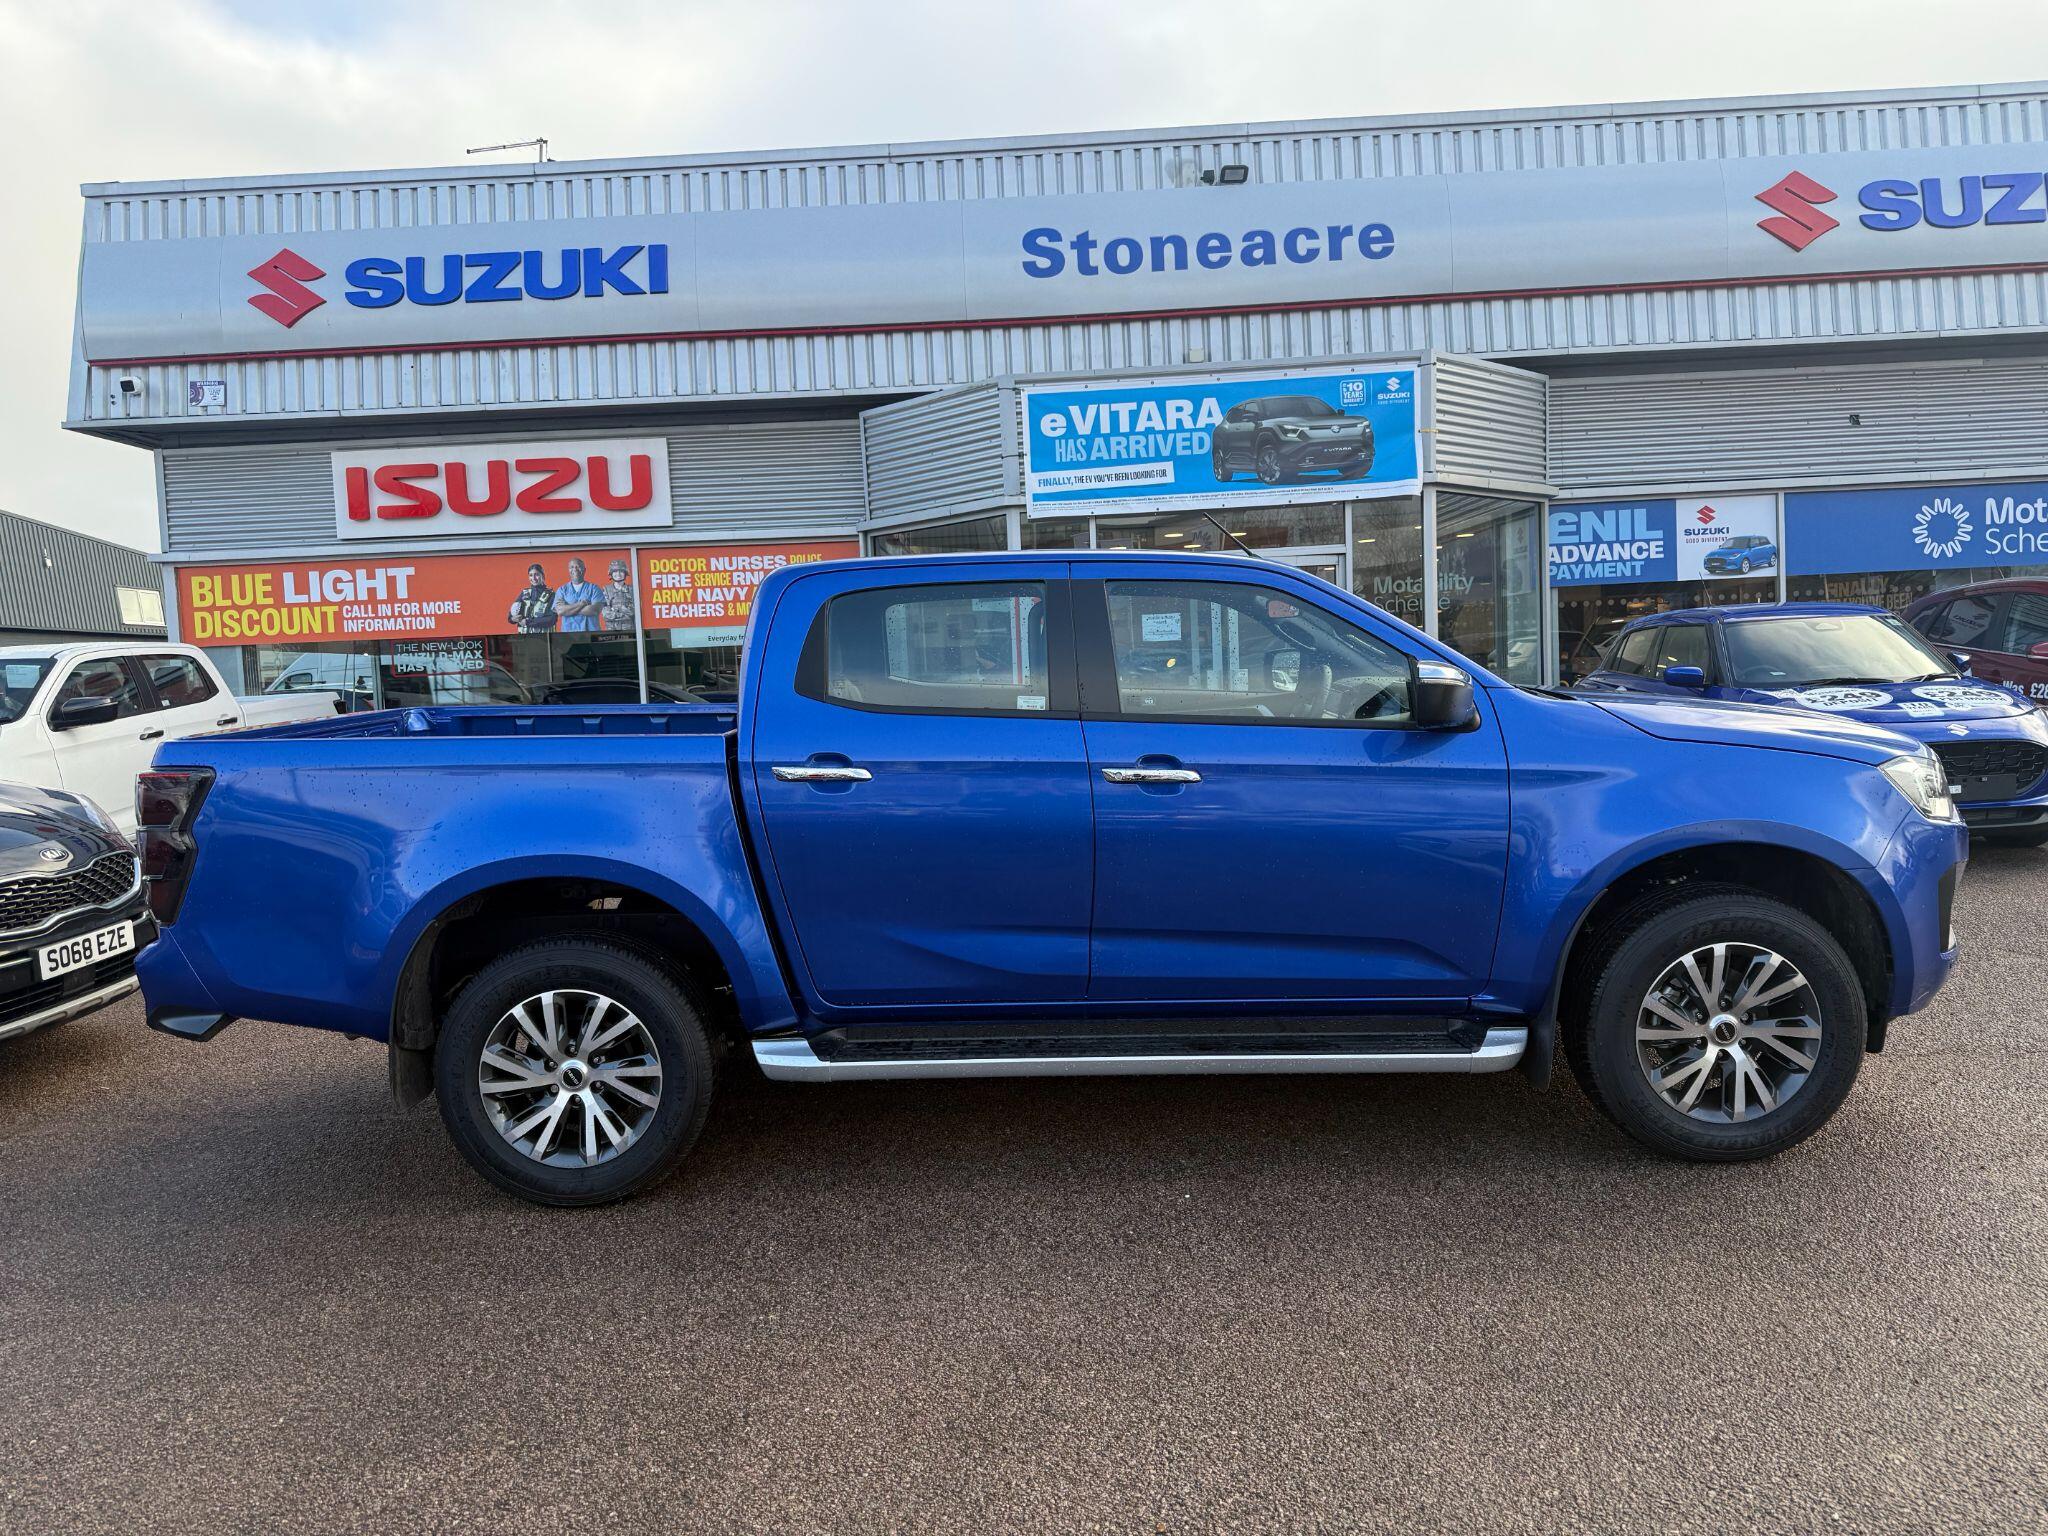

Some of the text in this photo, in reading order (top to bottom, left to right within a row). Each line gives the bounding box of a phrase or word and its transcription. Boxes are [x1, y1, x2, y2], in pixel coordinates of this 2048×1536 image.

[1858, 172, 2048, 232] SUZ
[1022, 221, 1395, 279] Stoneacre
[345, 244, 669, 309] SUZUKI
[1377, 392, 1411, 400] SUZUKI
[1055, 431, 1211, 463] HAS ARRIVED
[346, 454, 653, 521] ISUZU
[1038, 469, 1168, 488] FINALLY, THE EV YOU'VE BEEN LOOKING FOR
[1985, 496, 2048, 526] Mot
[1684, 527, 1729, 536] SUZUKI
[1549, 541, 1665, 564] ADVANCE
[650, 557, 707, 573] DOCTOR
[710, 555, 787, 571] NURSES
[191, 566, 415, 608] BLUE LIGHT
[651, 573, 692, 588] FIRE
[694, 572, 732, 587] SERVICE
[1373, 572, 1475, 595] Motaility
[652, 589, 693, 604] ARMY
[697, 586, 749, 602] NAVY
[1373, 595, 1451, 613] Schee
[342, 600, 461, 618] CALL IN FOR MORE
[653, 602, 751, 619] TEACHERS & MO
[193, 605, 339, 639] DISCOUNT
[343, 617, 436, 633] INFORMATION
[396, 640, 483, 652] THE NEW-LOOK
[708, 634, 737, 642] Everyday
[397, 662, 424, 673] HAS
[47, 925, 128, 973] SO68 EZE
